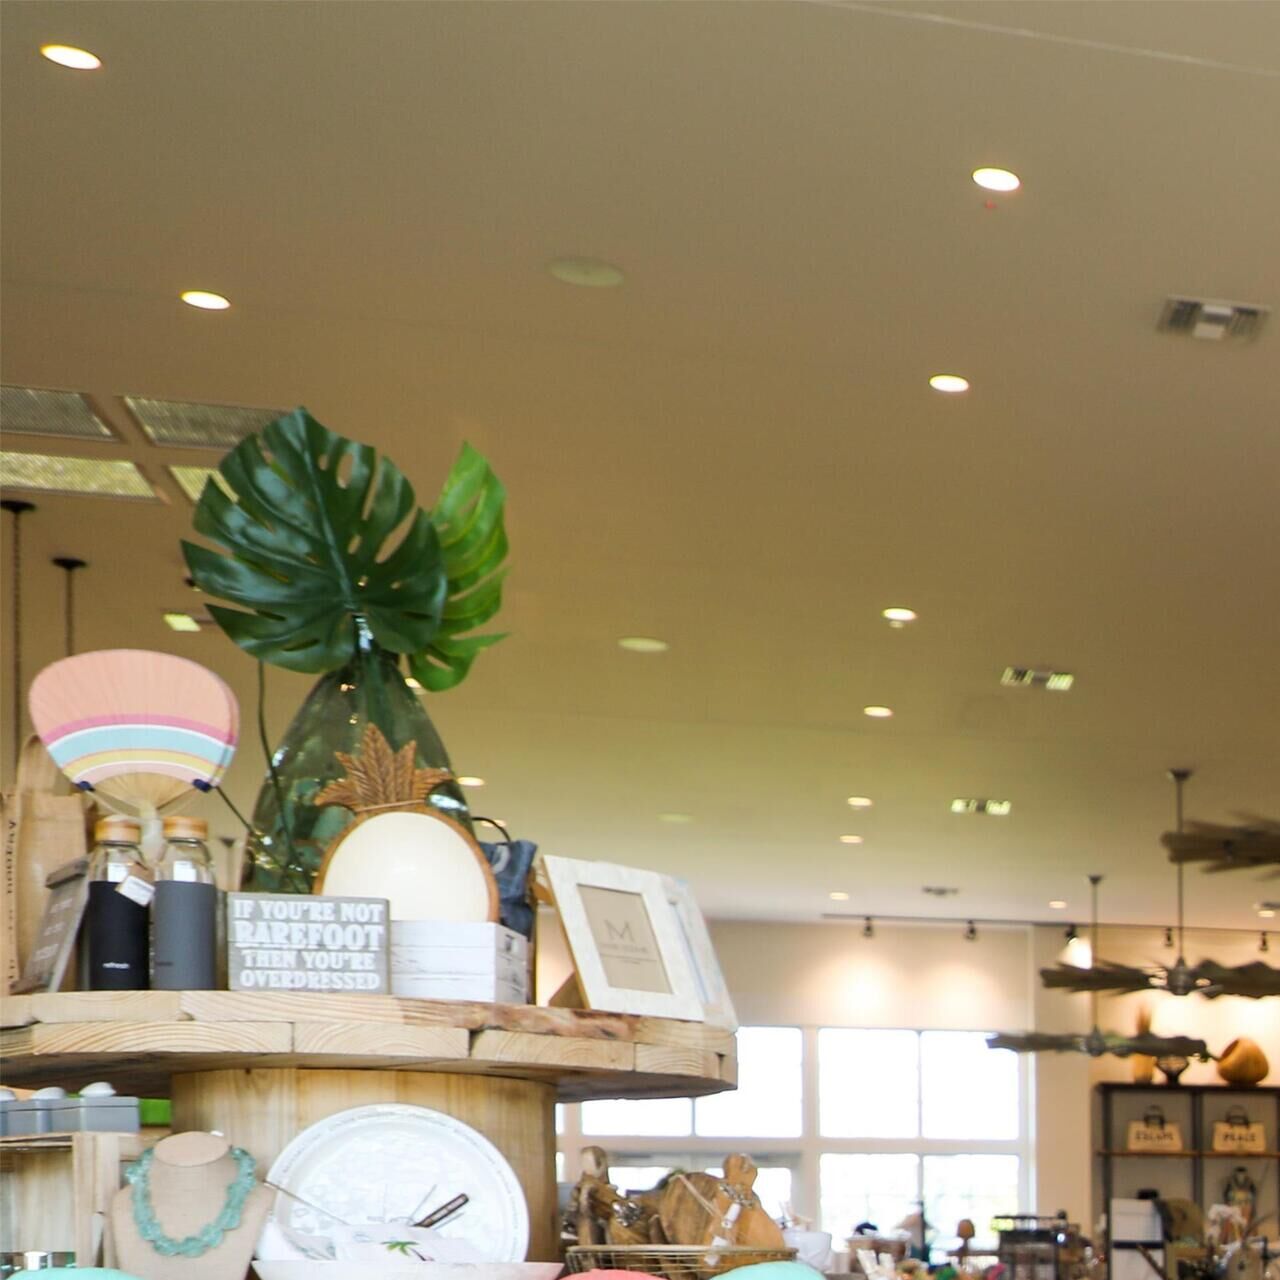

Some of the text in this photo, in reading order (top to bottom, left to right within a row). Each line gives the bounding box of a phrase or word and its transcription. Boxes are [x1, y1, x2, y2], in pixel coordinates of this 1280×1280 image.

[232, 899, 385, 923] IF YOU'RE NOT
[233, 919, 385, 951] BAREFOOT
[241, 949, 377, 970] THEN YOU'RE
[239, 969, 381, 990] OVERDRESSED
